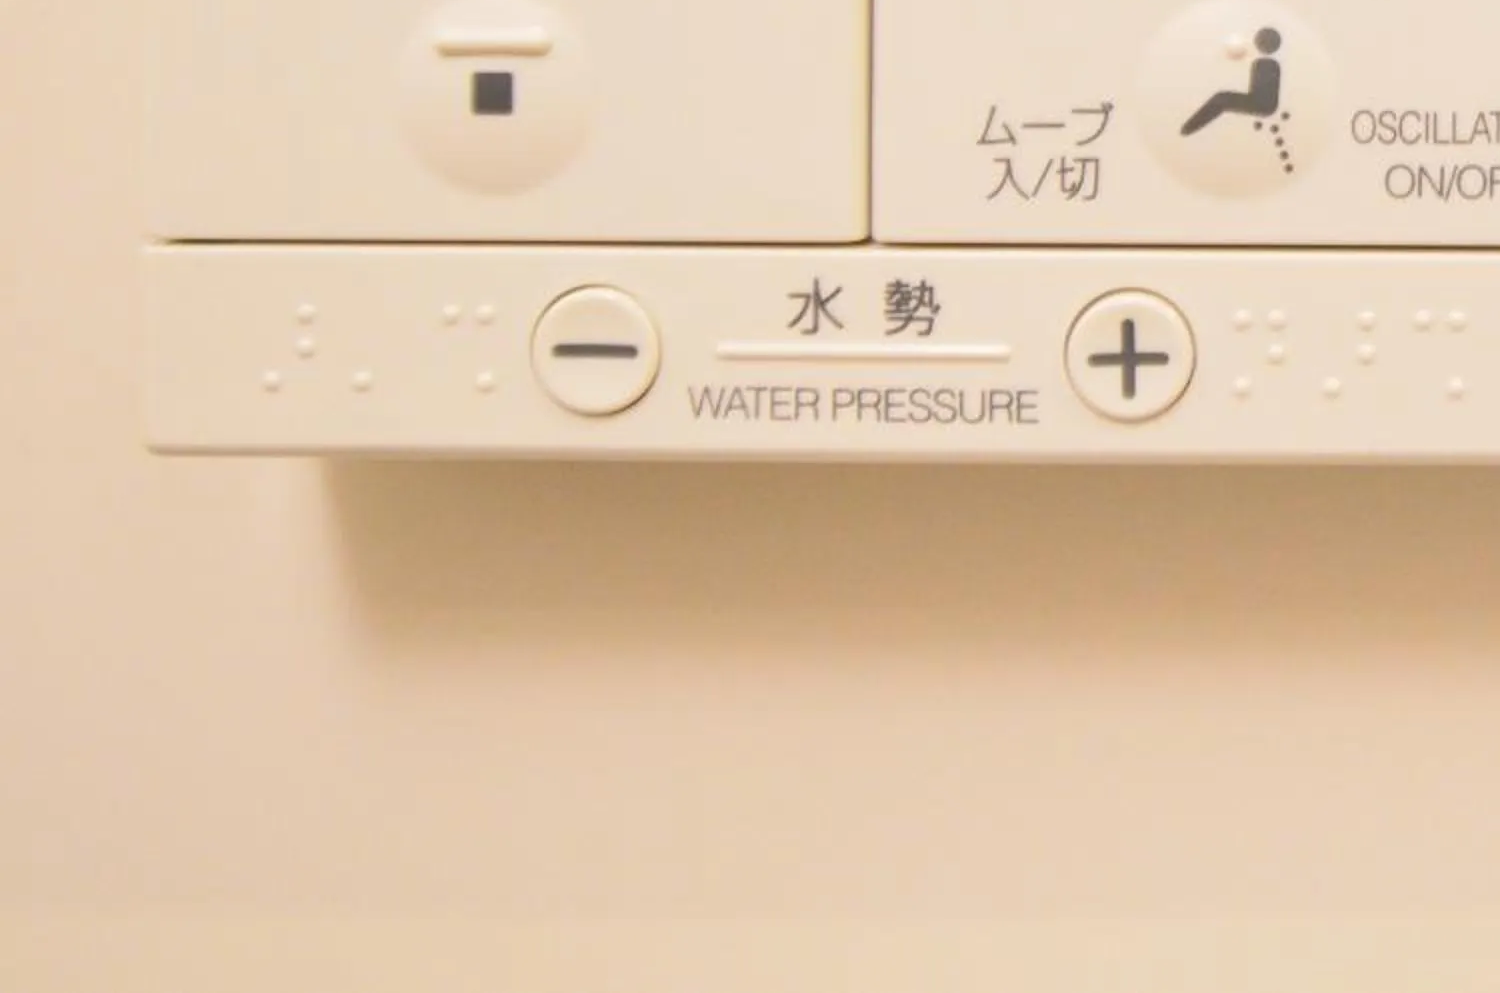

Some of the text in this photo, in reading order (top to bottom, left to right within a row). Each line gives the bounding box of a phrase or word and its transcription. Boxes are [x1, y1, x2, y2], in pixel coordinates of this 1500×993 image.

[975, 101, 1115, 147] ムーブ
[688, 386, 1040, 424] WATER PRESSURE
